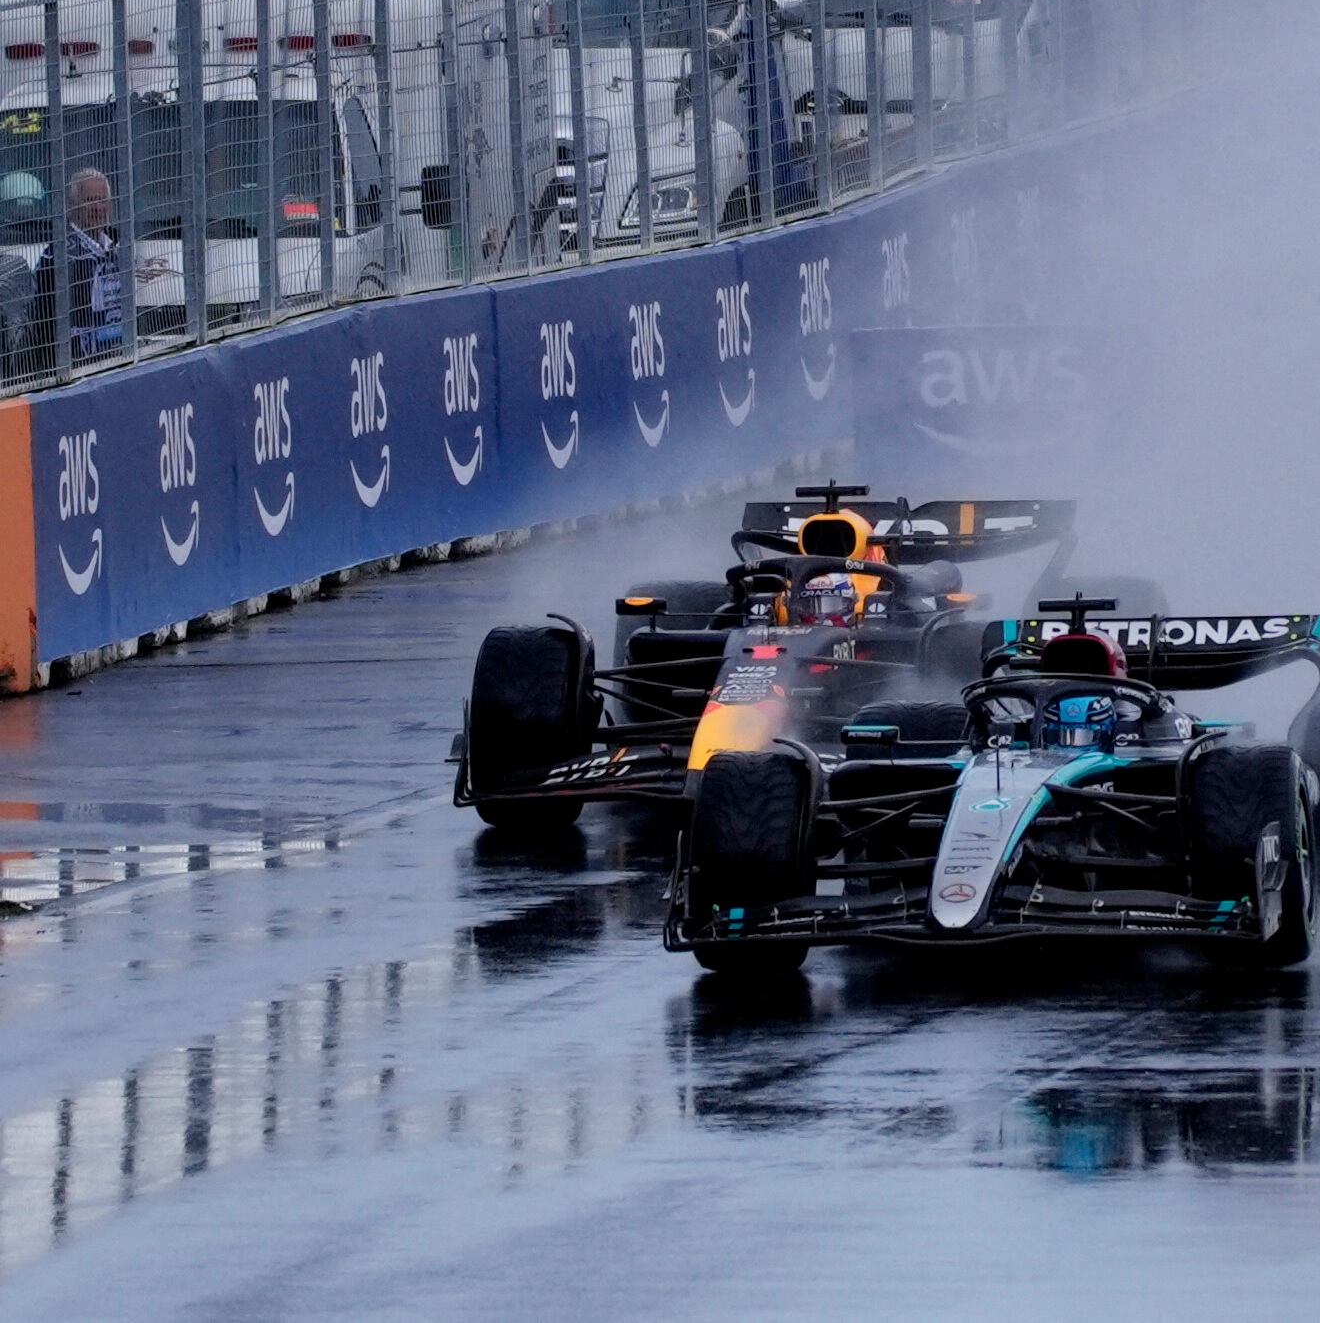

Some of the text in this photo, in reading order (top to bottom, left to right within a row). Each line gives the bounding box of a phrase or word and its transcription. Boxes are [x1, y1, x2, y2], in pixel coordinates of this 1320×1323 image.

[716, 281, 752, 362] aws
[800, 258, 833, 337] aws
[443, 333, 480, 415] aws
[541, 320, 576, 400] aws
[629, 301, 665, 380] aws
[254, 377, 291, 465] aws
[350, 351, 387, 438] aws
[58, 429, 99, 521] aws
[158, 402, 196, 494] aws
[1042, 617, 1289, 648] PTRONAS
